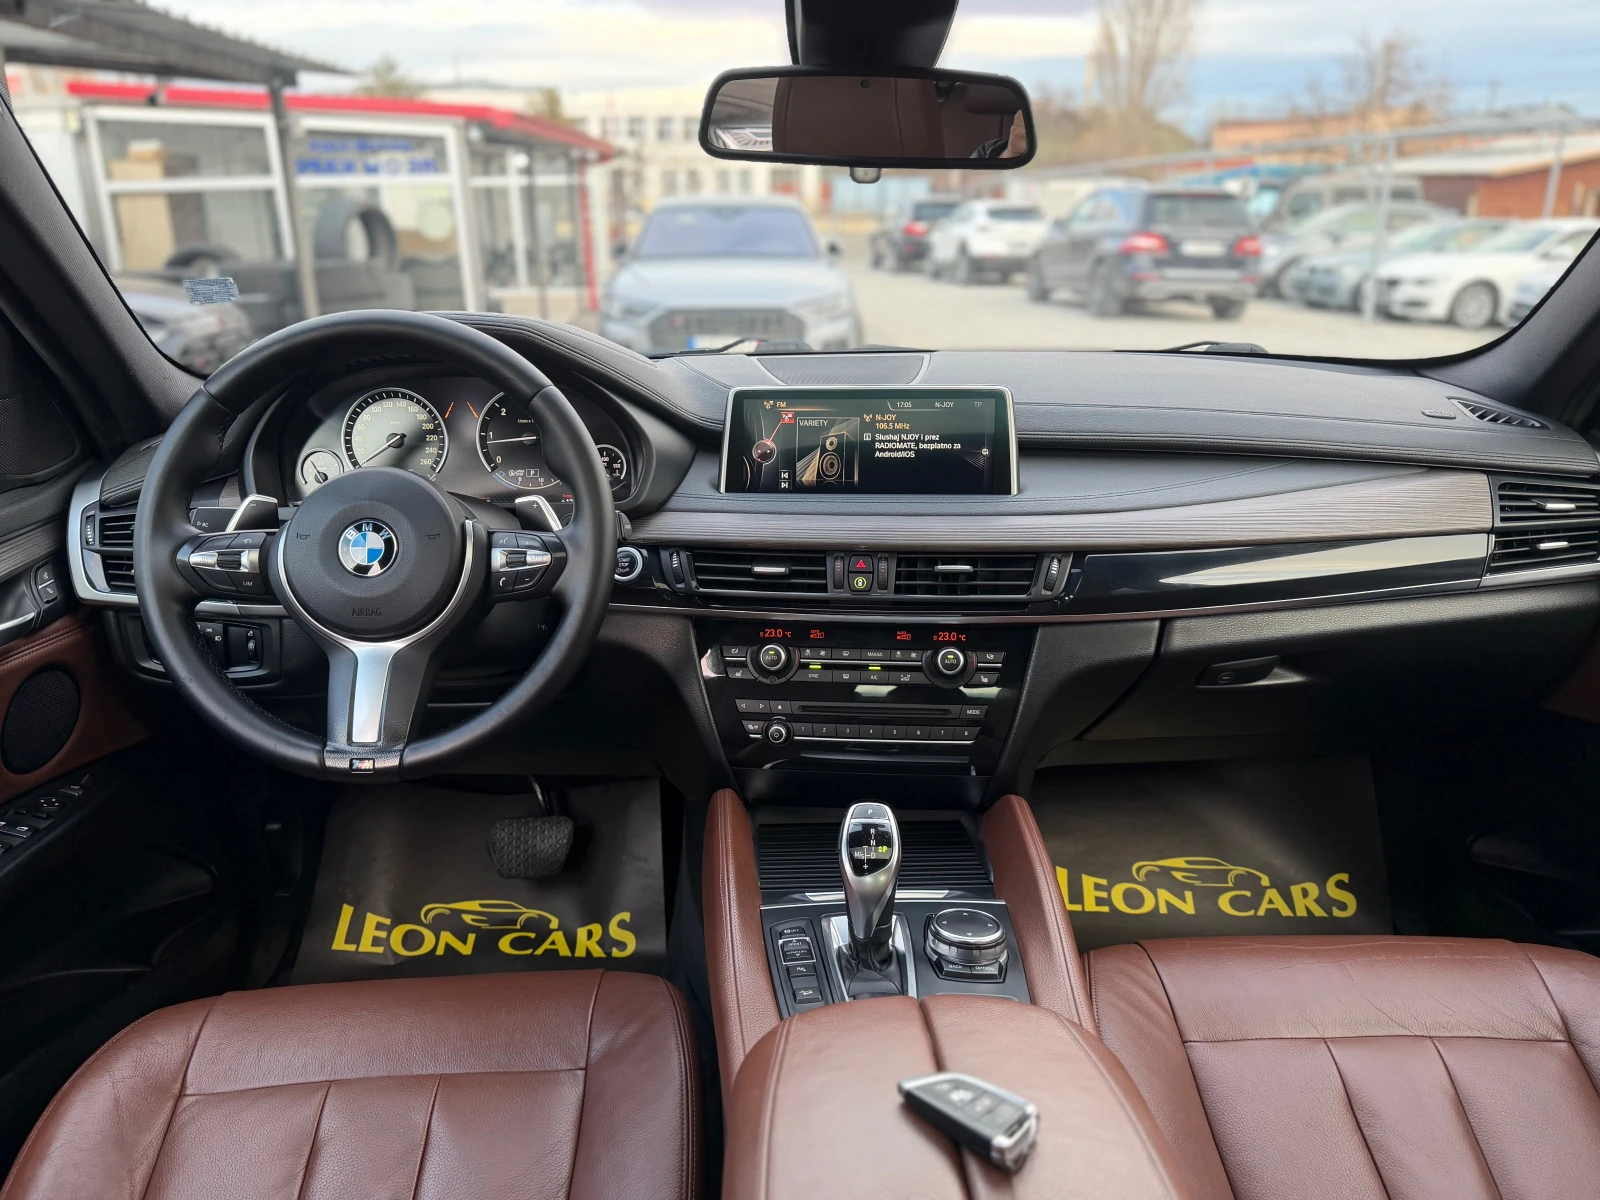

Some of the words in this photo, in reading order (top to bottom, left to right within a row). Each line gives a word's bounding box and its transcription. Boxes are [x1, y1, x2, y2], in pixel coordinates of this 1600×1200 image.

[500, 408, 507, 416] 2
[875, 413, 897, 421] N-JOY
[798, 419, 829, 427] VARIETY
[875, 422, 894, 430] 106.5
[894, 422, 910, 430] MHz
[488, 431, 494, 439] 1
[874, 433, 900, 442] Slushaj
[901, 433, 920, 441] NJOY
[924, 434, 940, 442] prez
[874, 442, 918, 450] RADIOMATE,
[918, 442, 952, 450] bezplatno
[345, 522, 392, 540] BMW
[351, 607, 382, 617] AIRBAG
[764, 628, 783, 638] 23.0
[938, 632, 957, 641] 23.0
[1217, 872, 1358, 918] CARS
[331, 903, 476, 957] LEON
[498, 911, 637, 958] CARS
